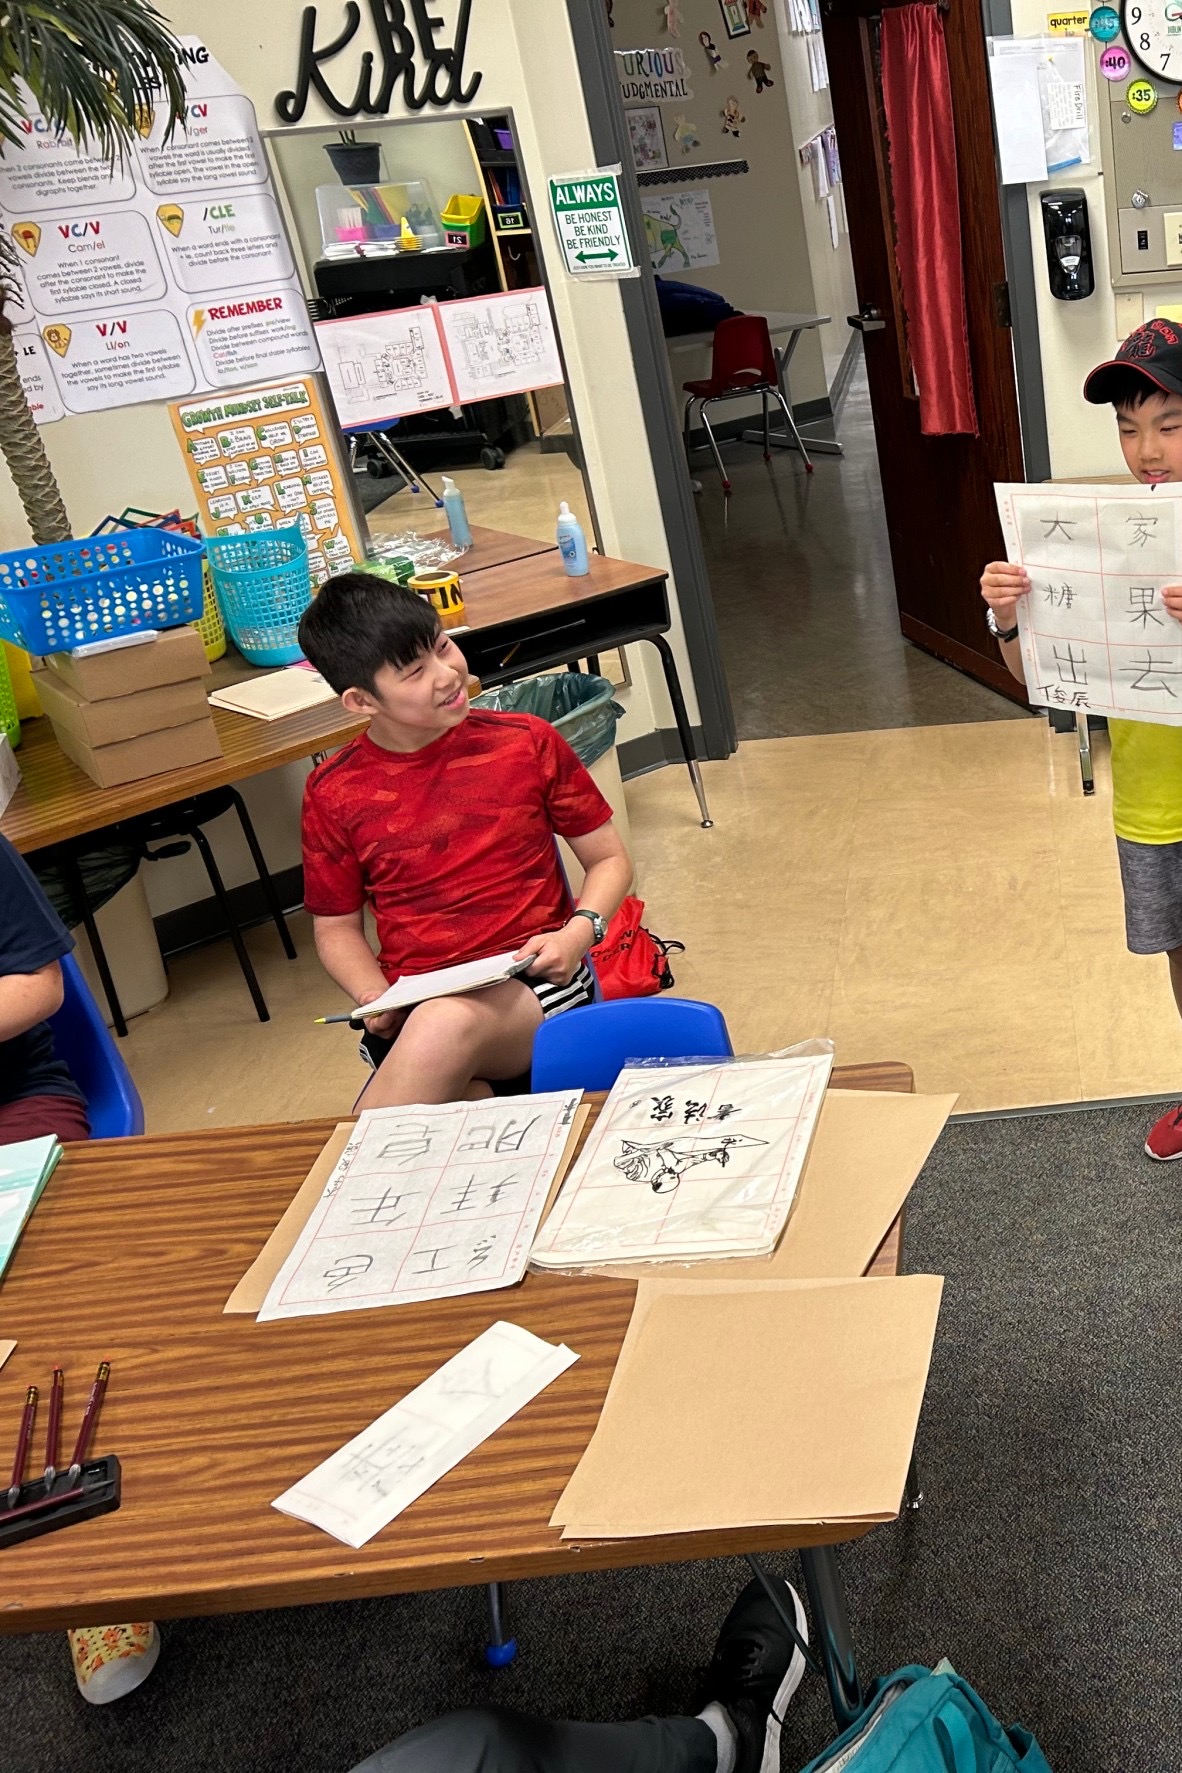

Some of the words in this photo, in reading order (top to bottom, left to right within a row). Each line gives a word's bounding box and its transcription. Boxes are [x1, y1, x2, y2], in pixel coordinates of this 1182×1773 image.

[1050, 16, 1087, 28] quarter
[1131, 7, 1142, 25] 9
[1140, 32, 1151, 51] 8
[275, 0, 483, 122] Kind
[622, 51, 685, 77] URIOUS
[1105, 56, 1126, 69] :40
[1159, 53, 1171, 71] 7
[621, 78, 688, 99] UDGMENTAL
[1131, 88, 1152, 102] :35
[556, 183, 615, 206] ALWAYS
[565, 214, 578, 225] BE
[578, 211, 612, 224] HONEST
[58, 221, 100, 239] VC/V
[574, 226, 587, 237] BE
[588, 223, 609, 236] KIND
[68, 240, 106, 253] Cam/el
[566, 239, 580, 250] BE
[580, 235, 621, 249] FRIENDLY
[207, 297, 283, 320] REMEMBER
[95, 320, 127, 337] V/V
